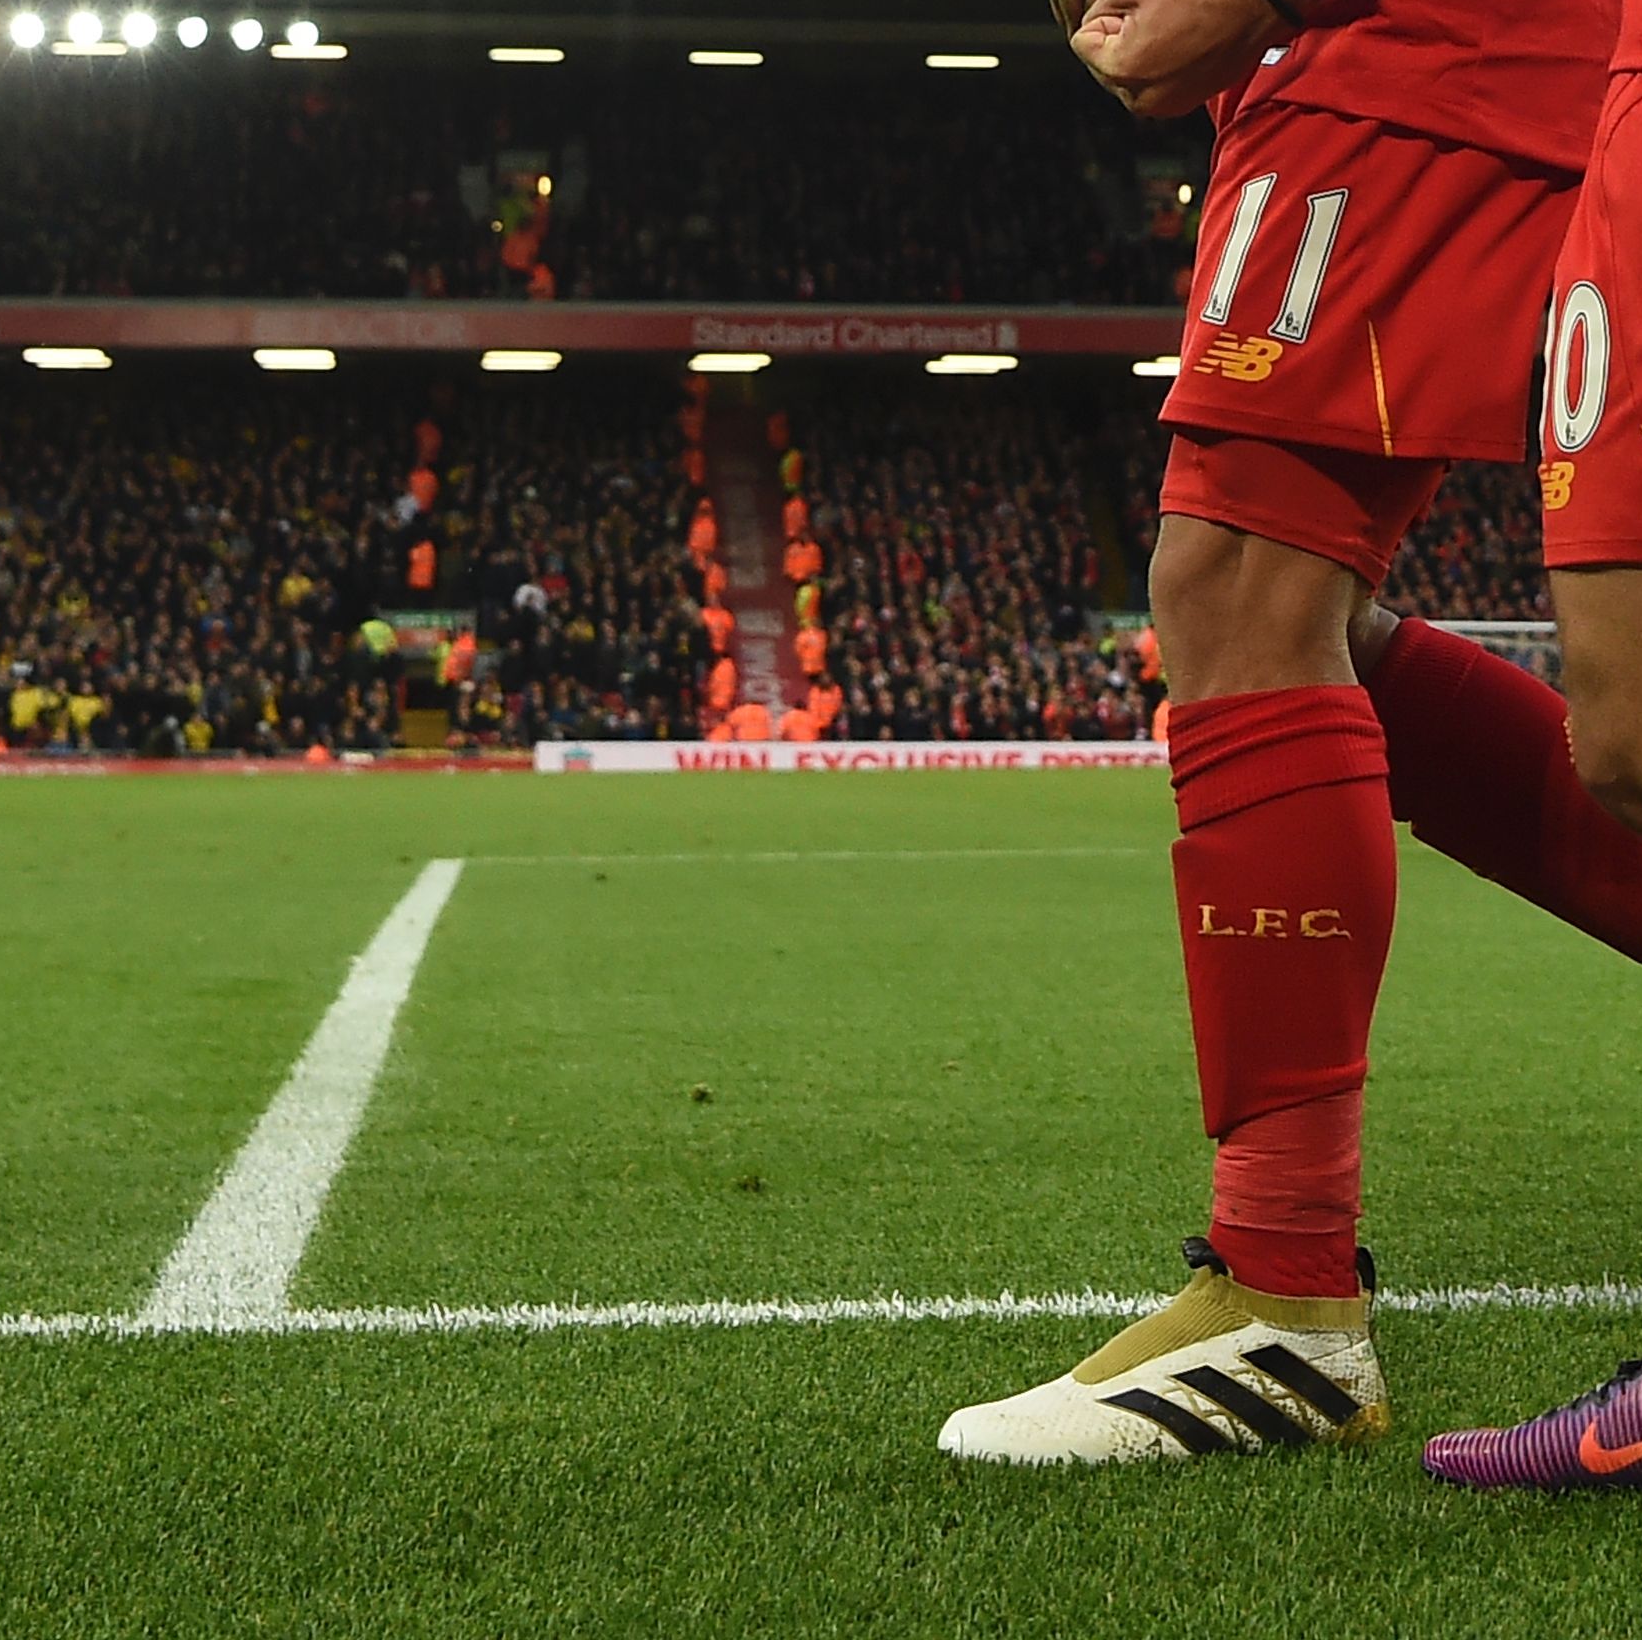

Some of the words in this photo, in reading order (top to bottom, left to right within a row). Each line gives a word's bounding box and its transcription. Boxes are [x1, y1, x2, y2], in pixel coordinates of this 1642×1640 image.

[1200, 172, 1348, 344] 11
[693, 316, 834, 347] Standard
[839, 317, 993, 348] Chartered
[1540, 280, 1611, 453] 0
[676, 750, 769, 770] WIN
